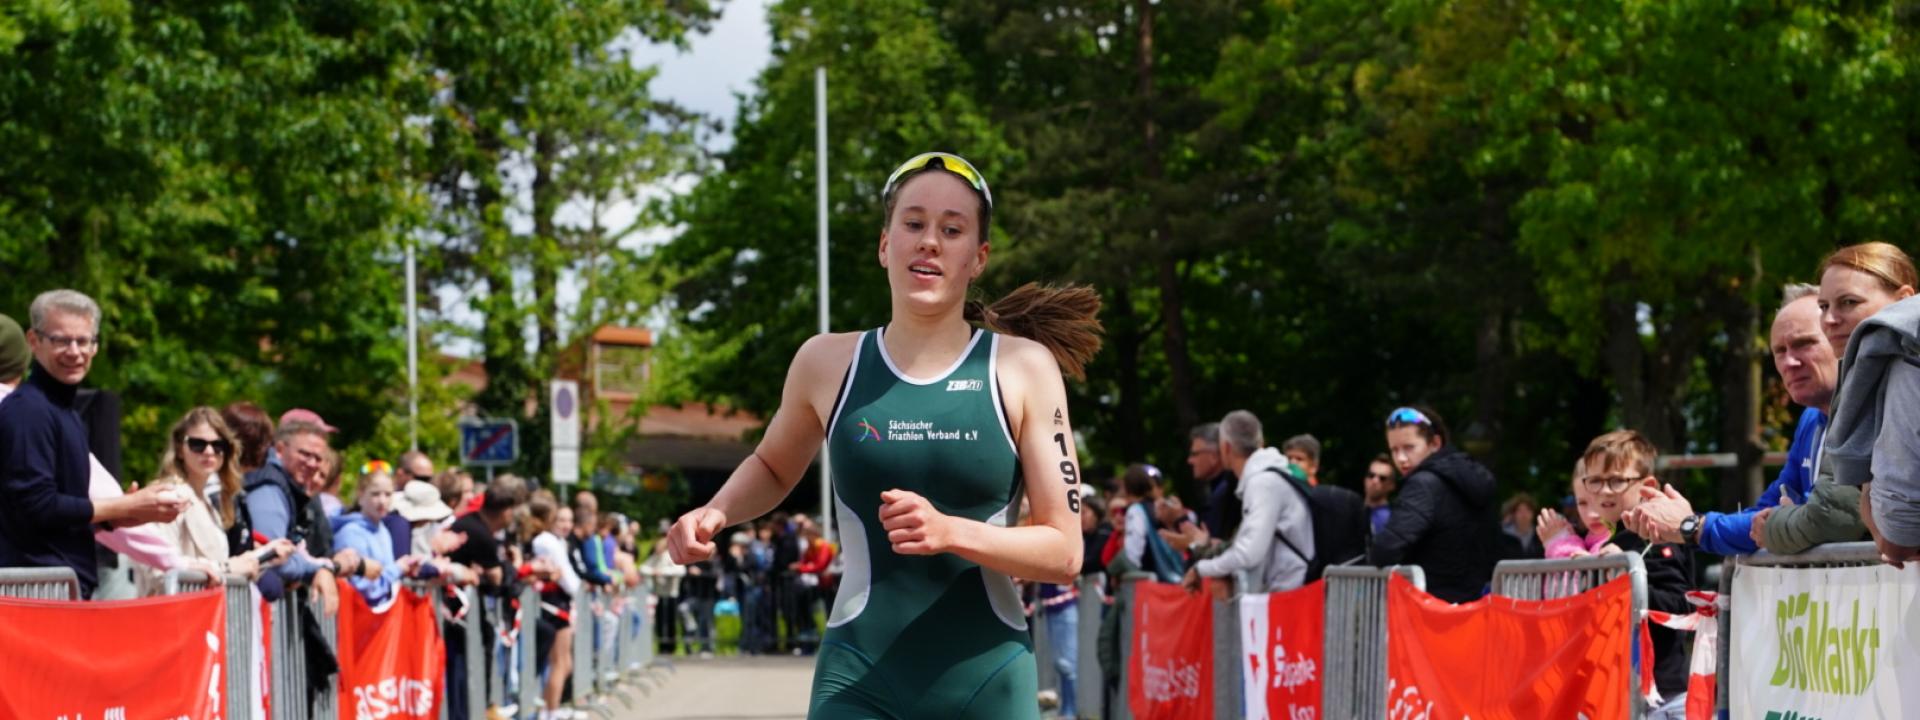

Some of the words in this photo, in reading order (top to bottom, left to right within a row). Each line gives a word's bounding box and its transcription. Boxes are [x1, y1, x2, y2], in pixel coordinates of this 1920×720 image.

[888, 419, 933, 430] Sächsischer
[888, 430, 924, 441] Triathlon
[927, 429, 960, 440] Verband
[1053, 432, 1080, 514] 196
